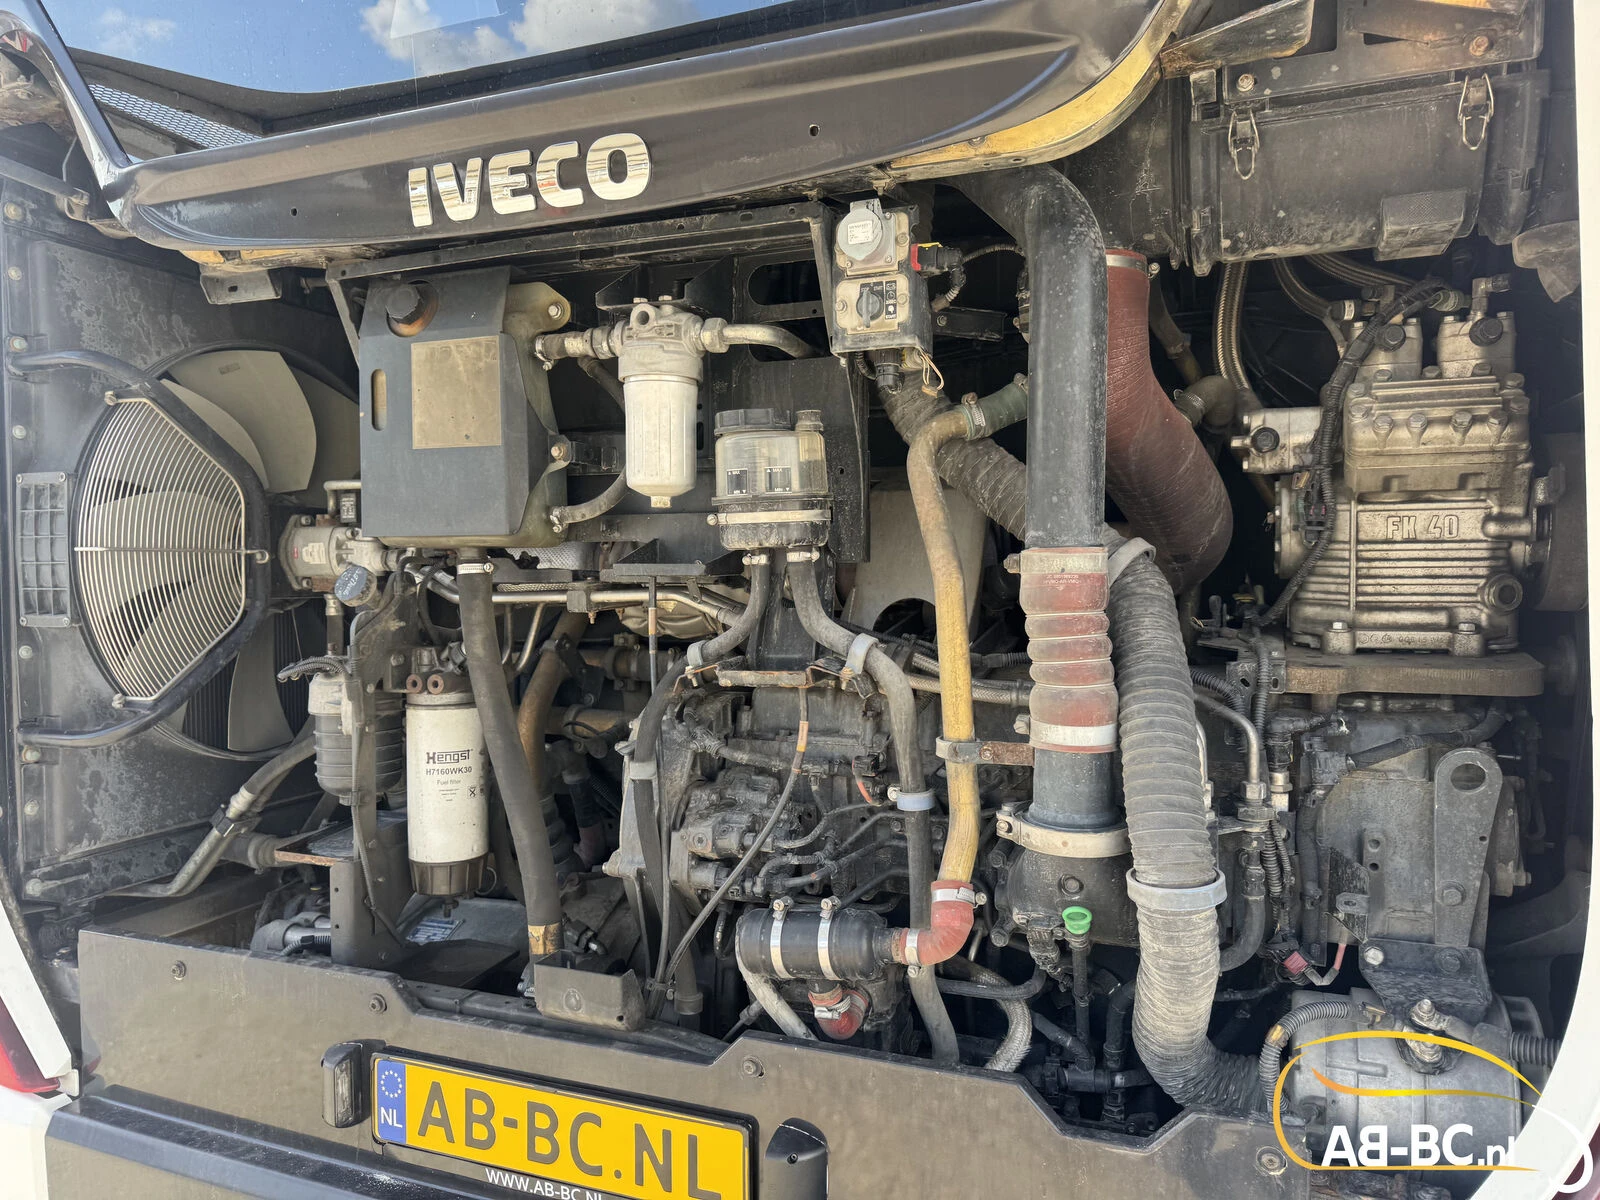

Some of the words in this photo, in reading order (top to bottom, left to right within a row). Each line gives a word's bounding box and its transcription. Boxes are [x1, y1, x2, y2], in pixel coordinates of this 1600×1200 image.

[408, 132, 650, 227] IVECO
[1386, 515, 1416, 540] FK
[1427, 514, 1459, 539] 40
[426, 749, 470, 765] Hengst
[425, 766, 473, 776] H7160WK30
[380, 1106, 403, 1129] NL
[417, 1080, 722, 1200] AB-BC.NL
